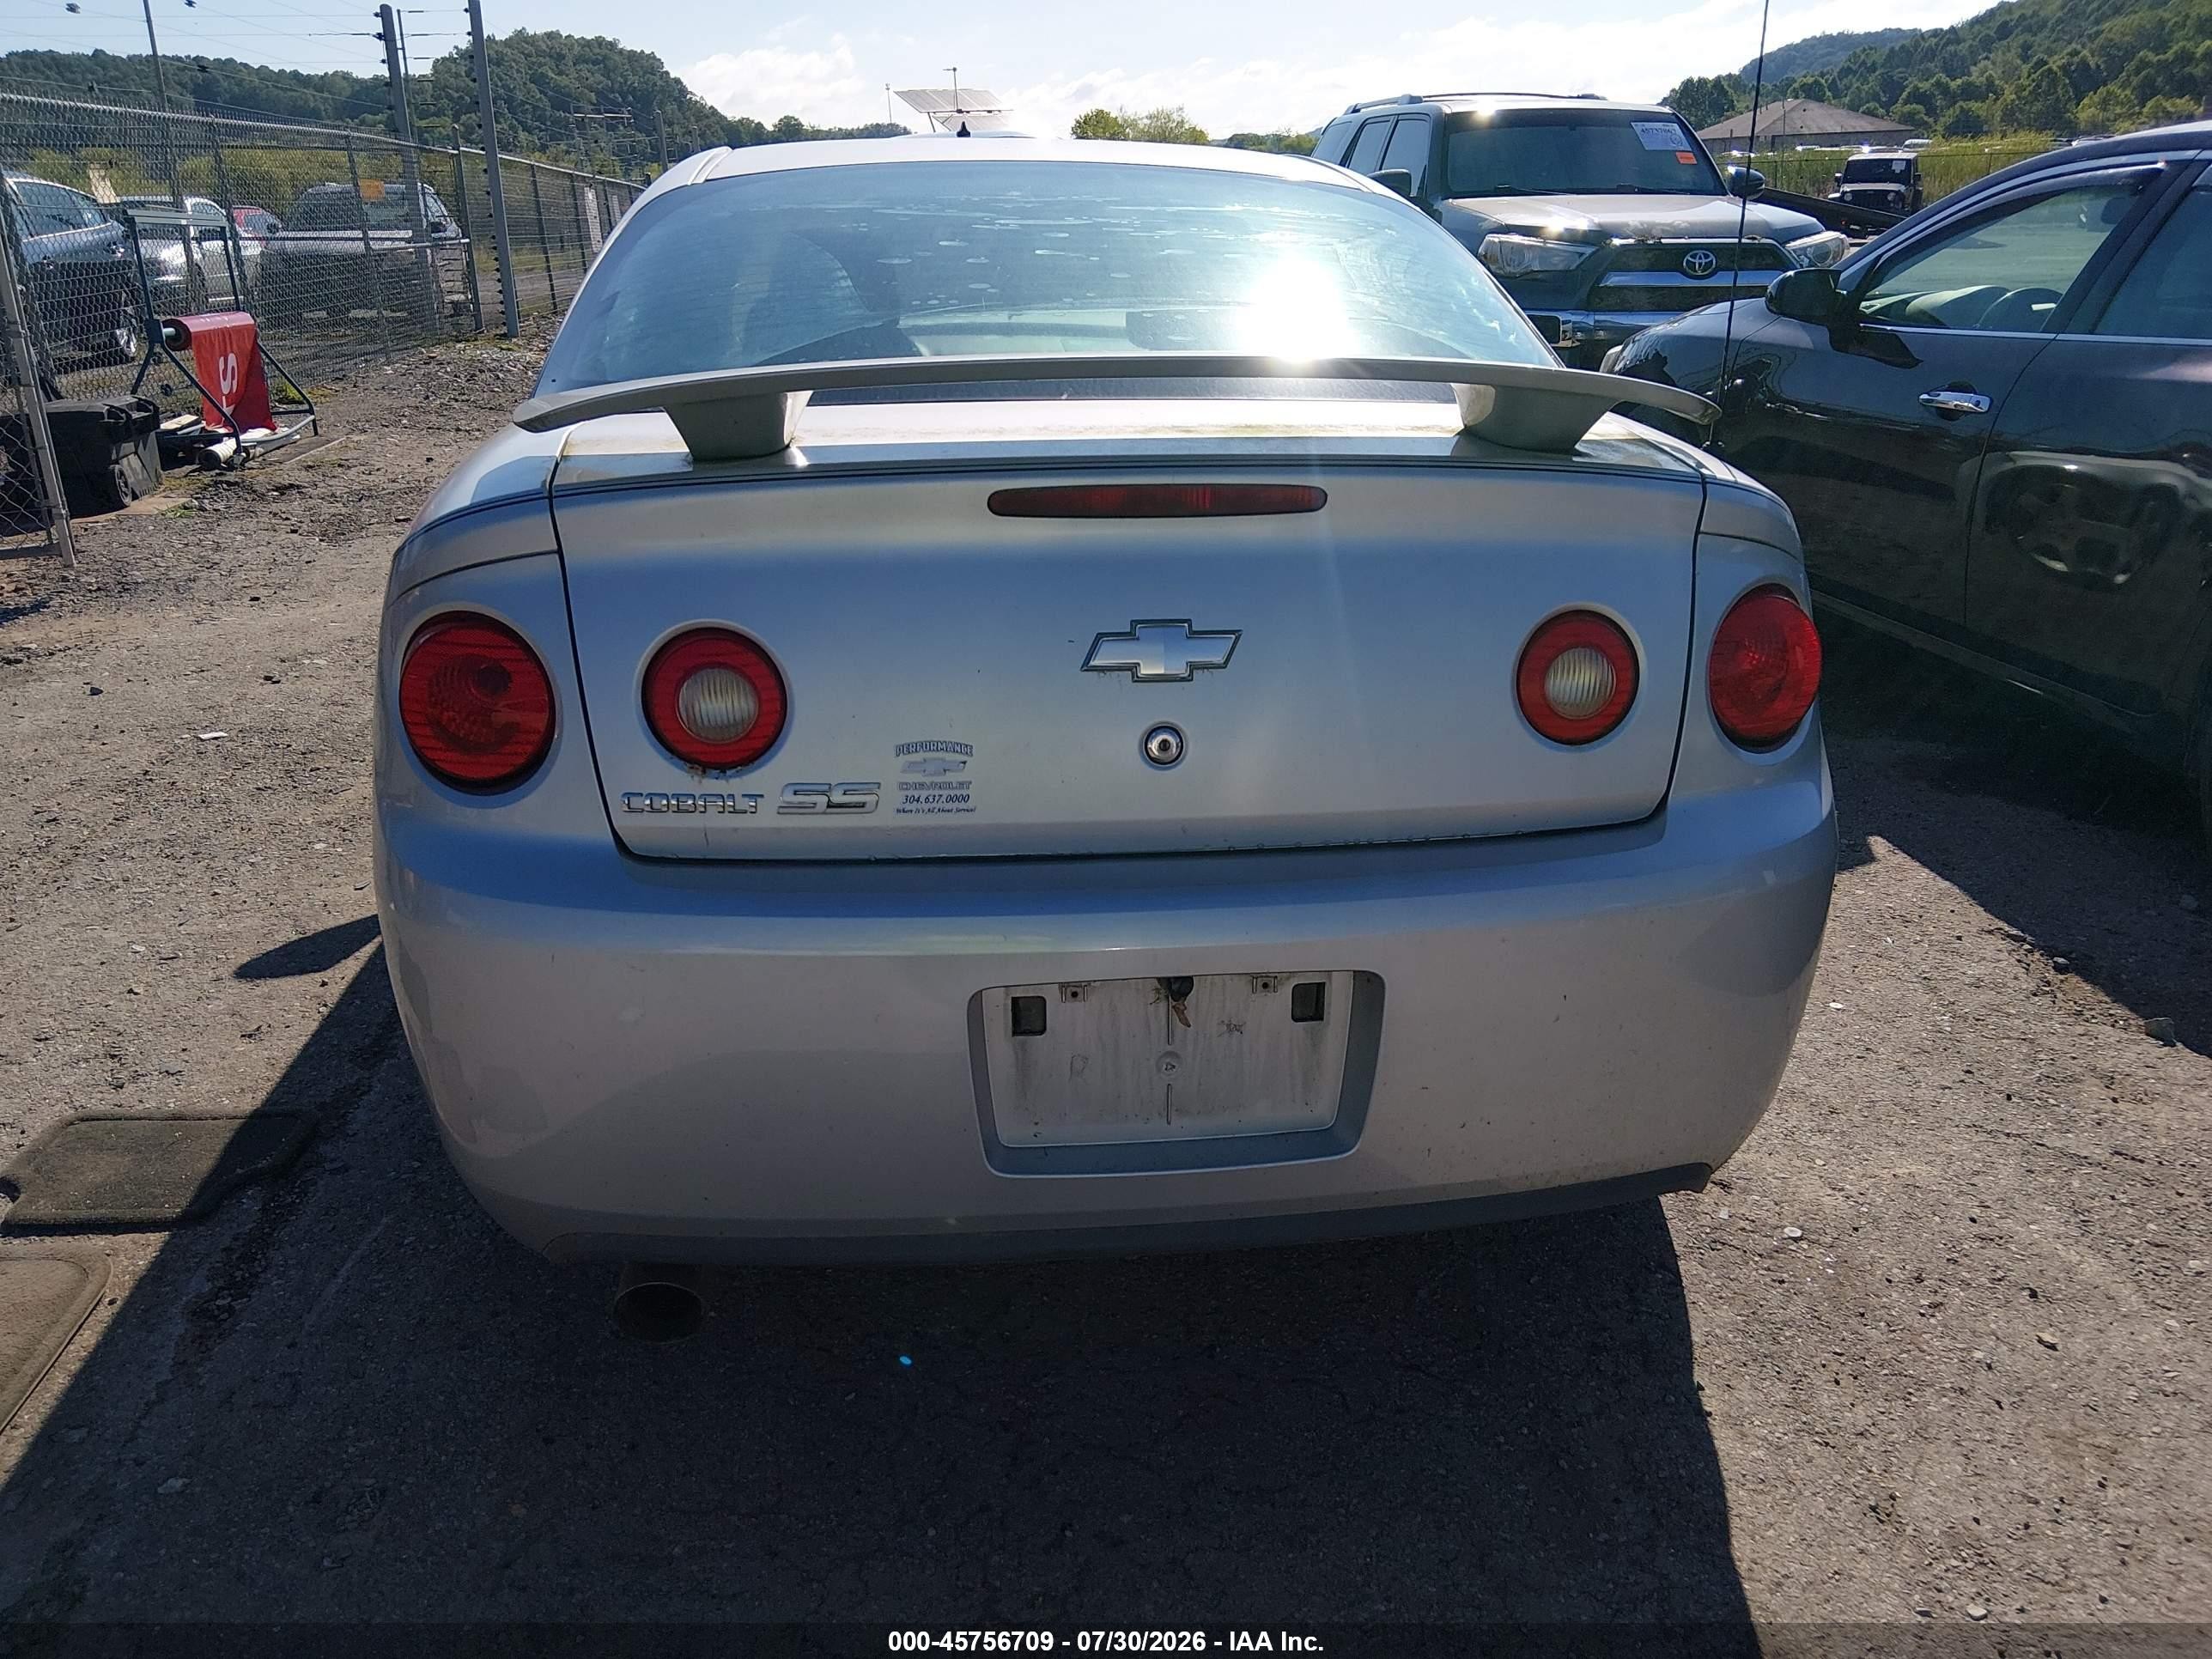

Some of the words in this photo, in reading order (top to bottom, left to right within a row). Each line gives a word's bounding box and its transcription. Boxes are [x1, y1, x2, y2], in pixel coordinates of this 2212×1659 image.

[895, 740, 974, 757] PERFORMANCE
[898, 781, 972, 791] CHEVROLET
[620, 793, 764, 815] COBALT
[777, 782, 882, 815] SS
[902, 793, 970, 805] 304.637.0000
